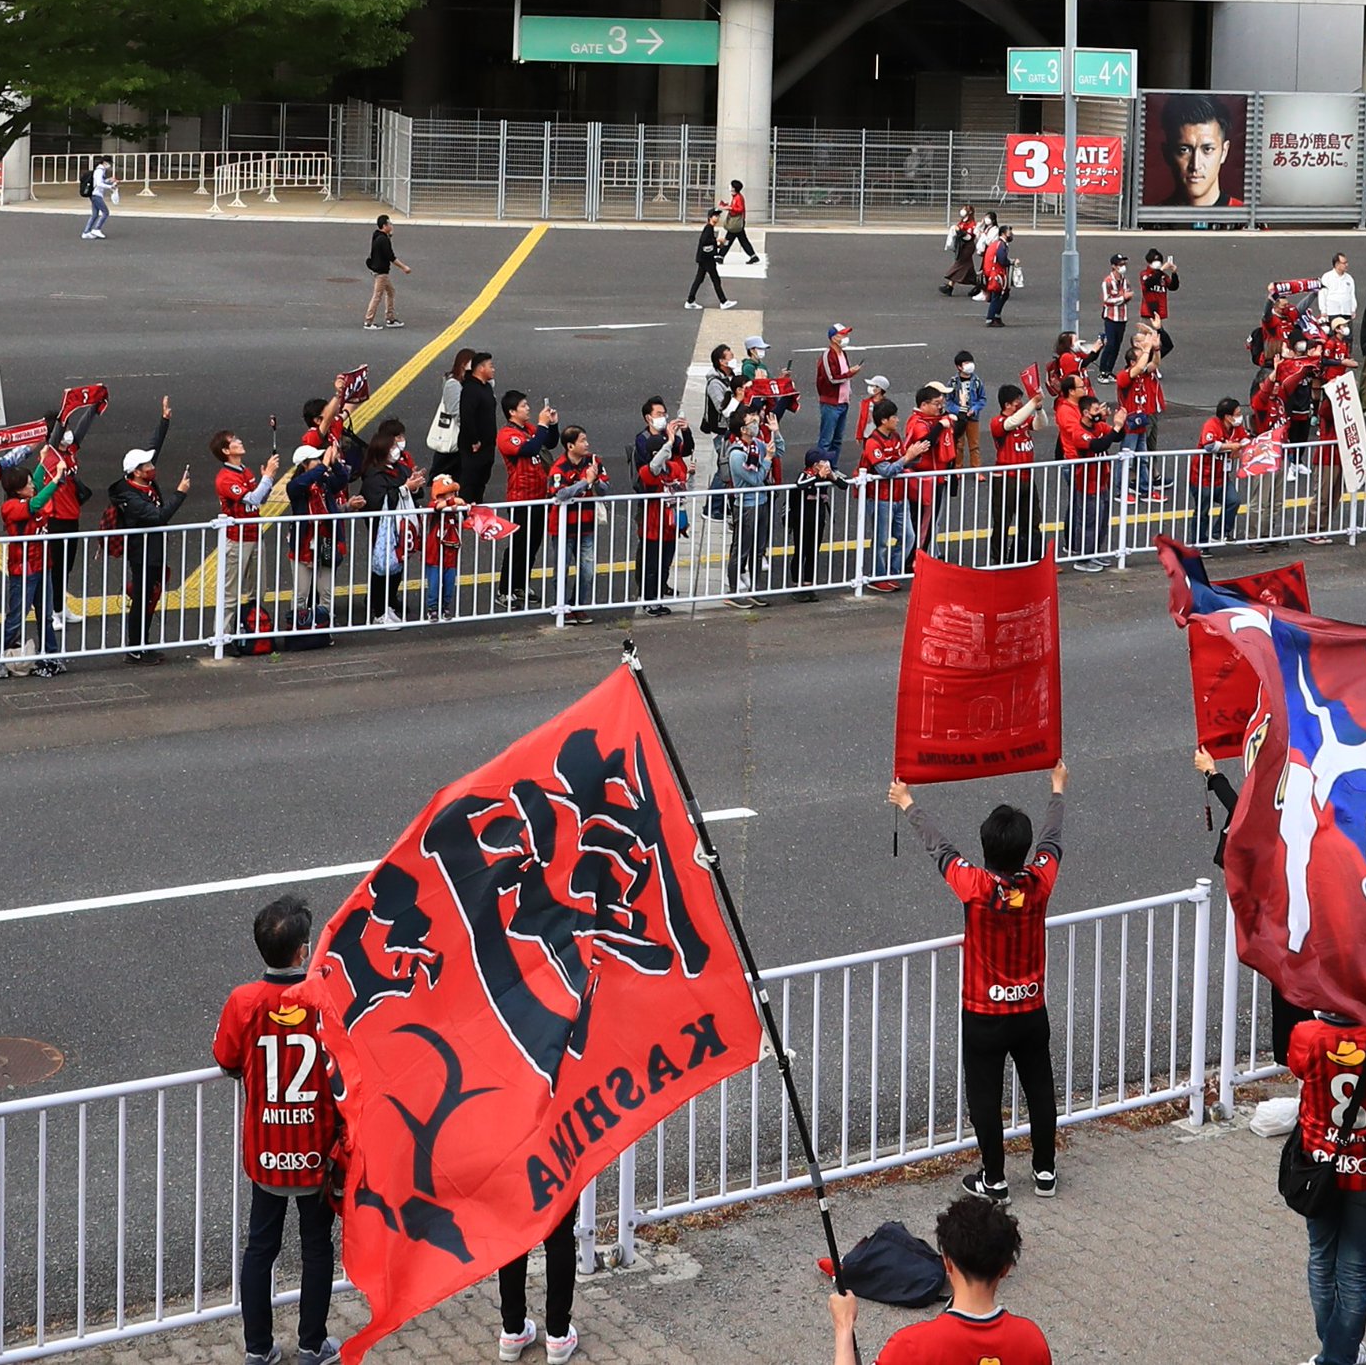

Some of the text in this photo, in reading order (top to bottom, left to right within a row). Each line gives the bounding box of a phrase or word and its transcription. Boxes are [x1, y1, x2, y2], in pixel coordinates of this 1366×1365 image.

[570, 25, 627, 55] GATE 3
[1028, 59, 1058, 84] GATE 3
[1078, 61, 1111, 86] GATE 4
[1269, 134, 1354, 149] 鹿島が鹿島で
[1012, 140, 1110, 188] 3 ATE
[1273, 151, 1349, 167] あるために。
[1336, 382, 1364, 482] 共に闘おう
[1005, 983, 1039, 1002] RISO
[257, 1034, 318, 1103] 12
[262, 1107, 315, 1125] ANTLERS
[278, 1151, 322, 1170] RISO
